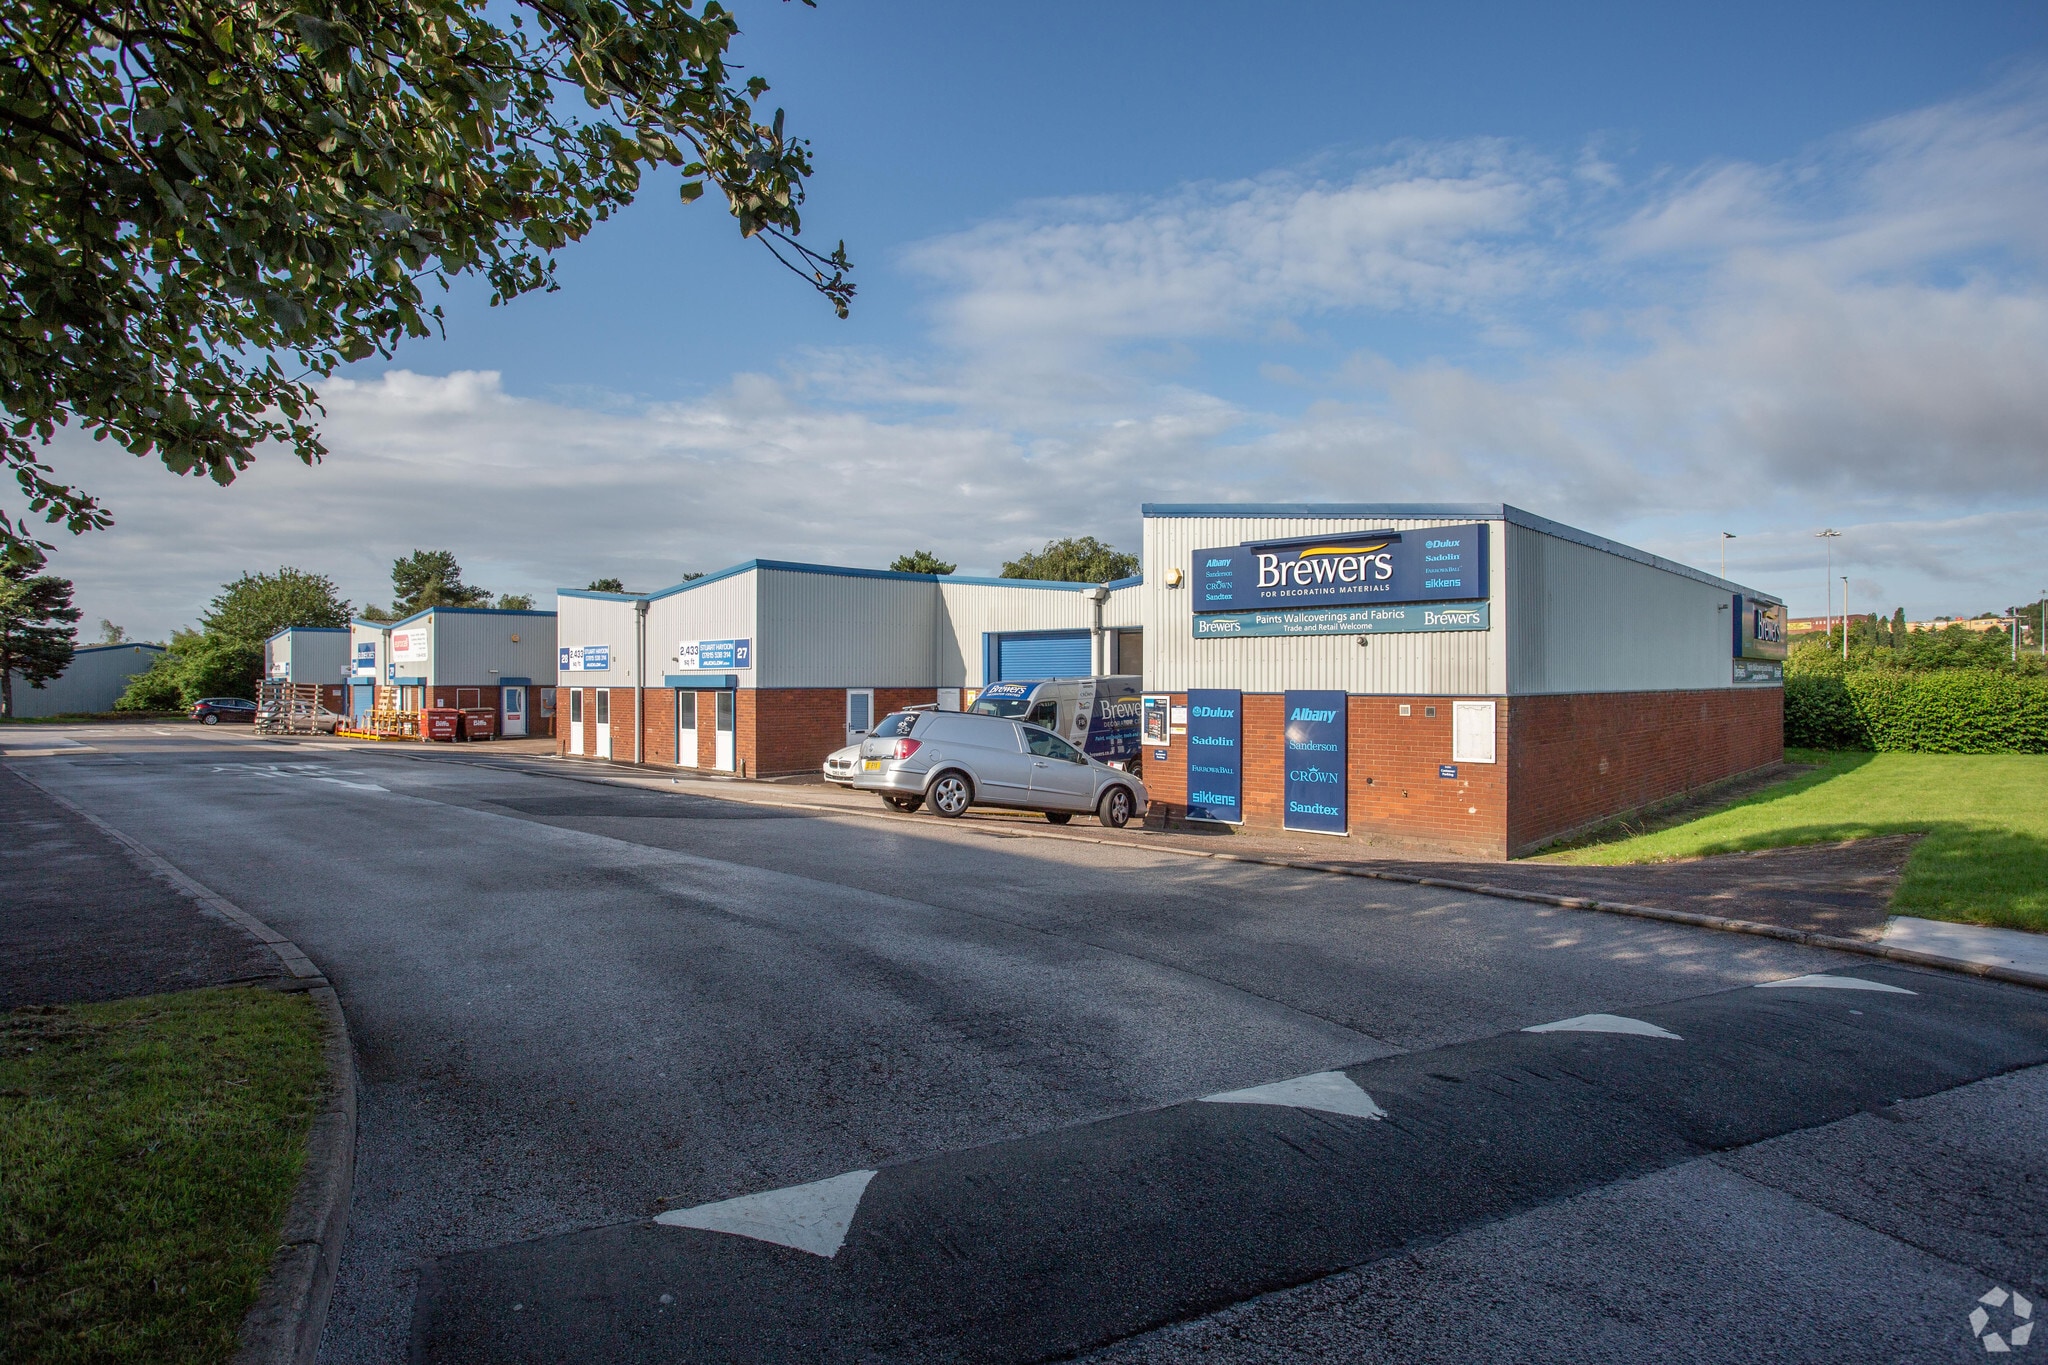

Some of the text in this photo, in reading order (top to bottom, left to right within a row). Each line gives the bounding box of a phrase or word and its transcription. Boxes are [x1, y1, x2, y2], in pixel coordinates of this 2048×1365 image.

[1433, 540, 1460, 548] Dulux
[1206, 559, 1232, 568] Albany
[1426, 554, 1460, 562] Sadolin
[1256, 552, 1393, 588] Brewers
[1206, 582, 1233, 590] CROWN
[1426, 579, 1461, 588] sikkens
[1280, 588, 1336, 596] DECORATING
[1340, 584, 1390, 593] MATERIALS
[1256, 610, 1404, 624] Paints Wallcoverings and Fabrics
[1424, 611, 1480, 625] Brewers
[1199, 620, 1240, 632] Brewers
[680, 646, 698, 656] 2,433
[737, 648, 748, 658] 27
[989, 685, 1026, 694] Brewers
[1202, 706, 1234, 718] Dulux
[1290, 708, 1336, 723] Albany
[1192, 736, 1234, 746] Sadolin
[1290, 740, 1338, 751] Sanderson
[1290, 770, 1338, 783] CROWN
[1192, 791, 1235, 806] sikkens
[1290, 801, 1338, 816] Sandtex
